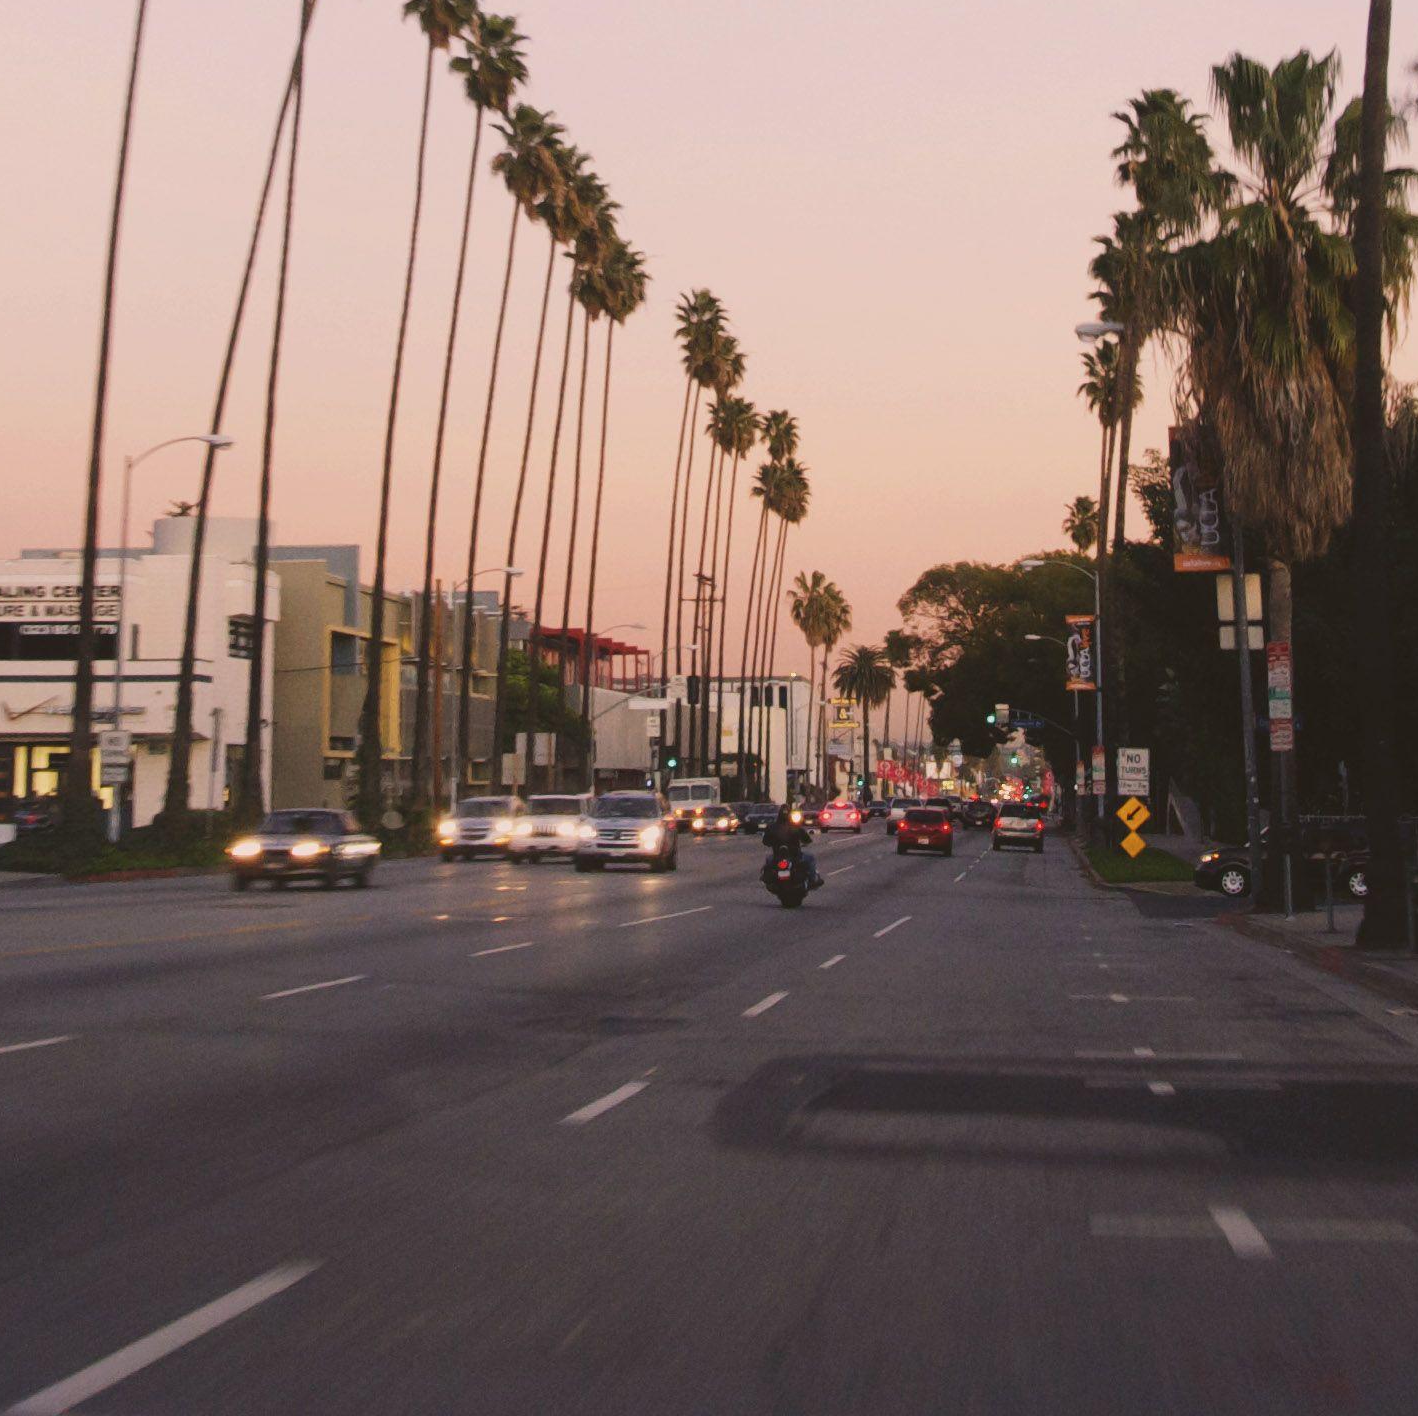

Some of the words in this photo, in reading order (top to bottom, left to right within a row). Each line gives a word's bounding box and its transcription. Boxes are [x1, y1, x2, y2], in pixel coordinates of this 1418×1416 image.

[1199, 488, 1220, 545] UCLA
[52, 585, 121, 599] CENER
[44, 604, 119, 618] MASGE
[1079, 648, 1091, 678] UCLA
[1126, 754, 1141, 764] NO
